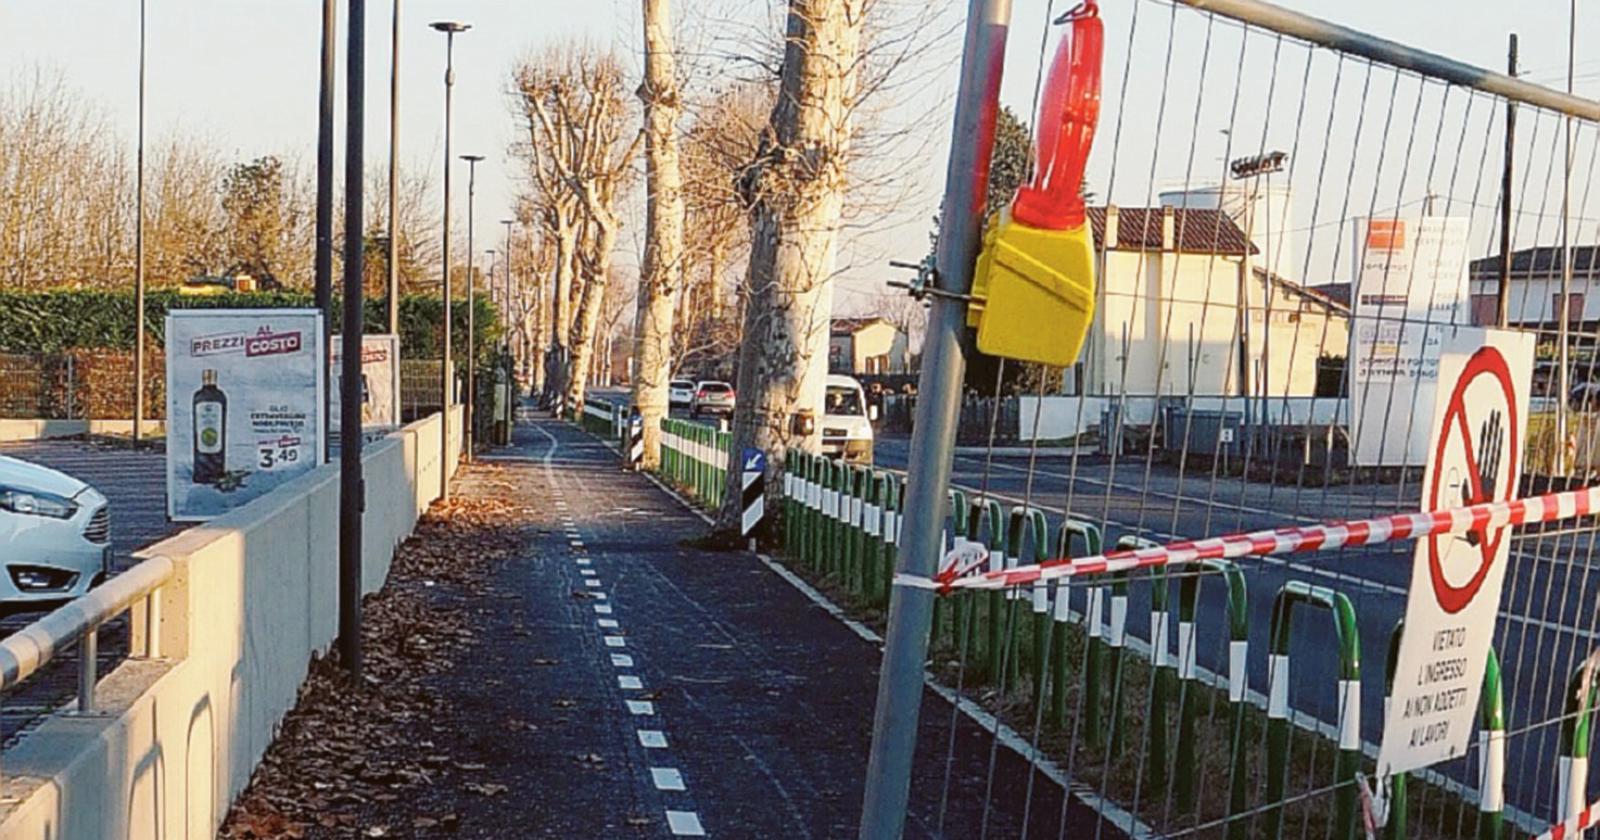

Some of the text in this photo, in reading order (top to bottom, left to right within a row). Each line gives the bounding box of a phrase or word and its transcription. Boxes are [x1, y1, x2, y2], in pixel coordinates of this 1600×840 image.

[257, 324, 272, 336] AL
[193, 337, 244, 353] PREZZI
[249, 336, 298, 354] COSTO
[1433, 627, 1466, 651] VIETATO
[1433, 687, 1467, 713] ADDETTI
[1420, 719, 1450, 747] LAVORI
